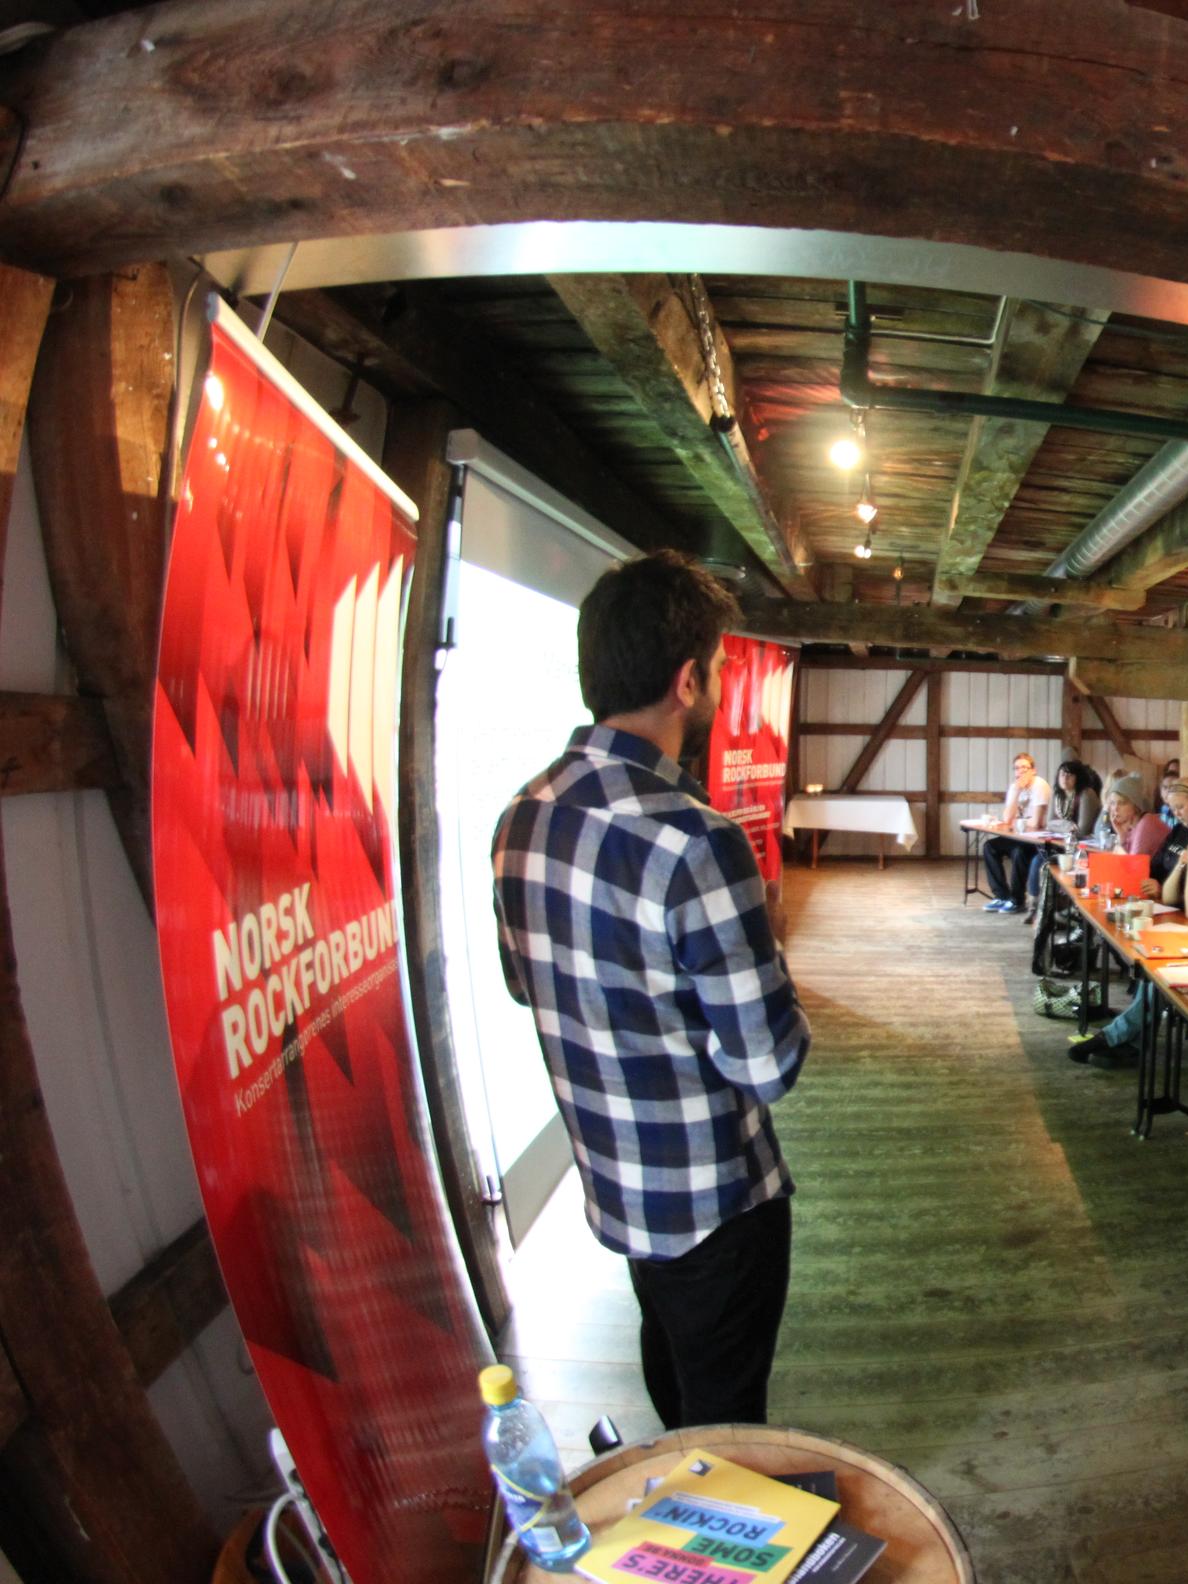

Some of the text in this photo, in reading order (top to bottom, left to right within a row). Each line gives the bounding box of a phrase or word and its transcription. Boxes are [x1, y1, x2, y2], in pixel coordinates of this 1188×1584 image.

[722, 749, 753, 766] NORSK
[722, 763, 787, 784] ROCKFORBUND
[213, 882, 315, 1002] NORSK
[655, 1505, 768, 1541] ROCKIN'
[691, 1536, 776, 1567] SOME
